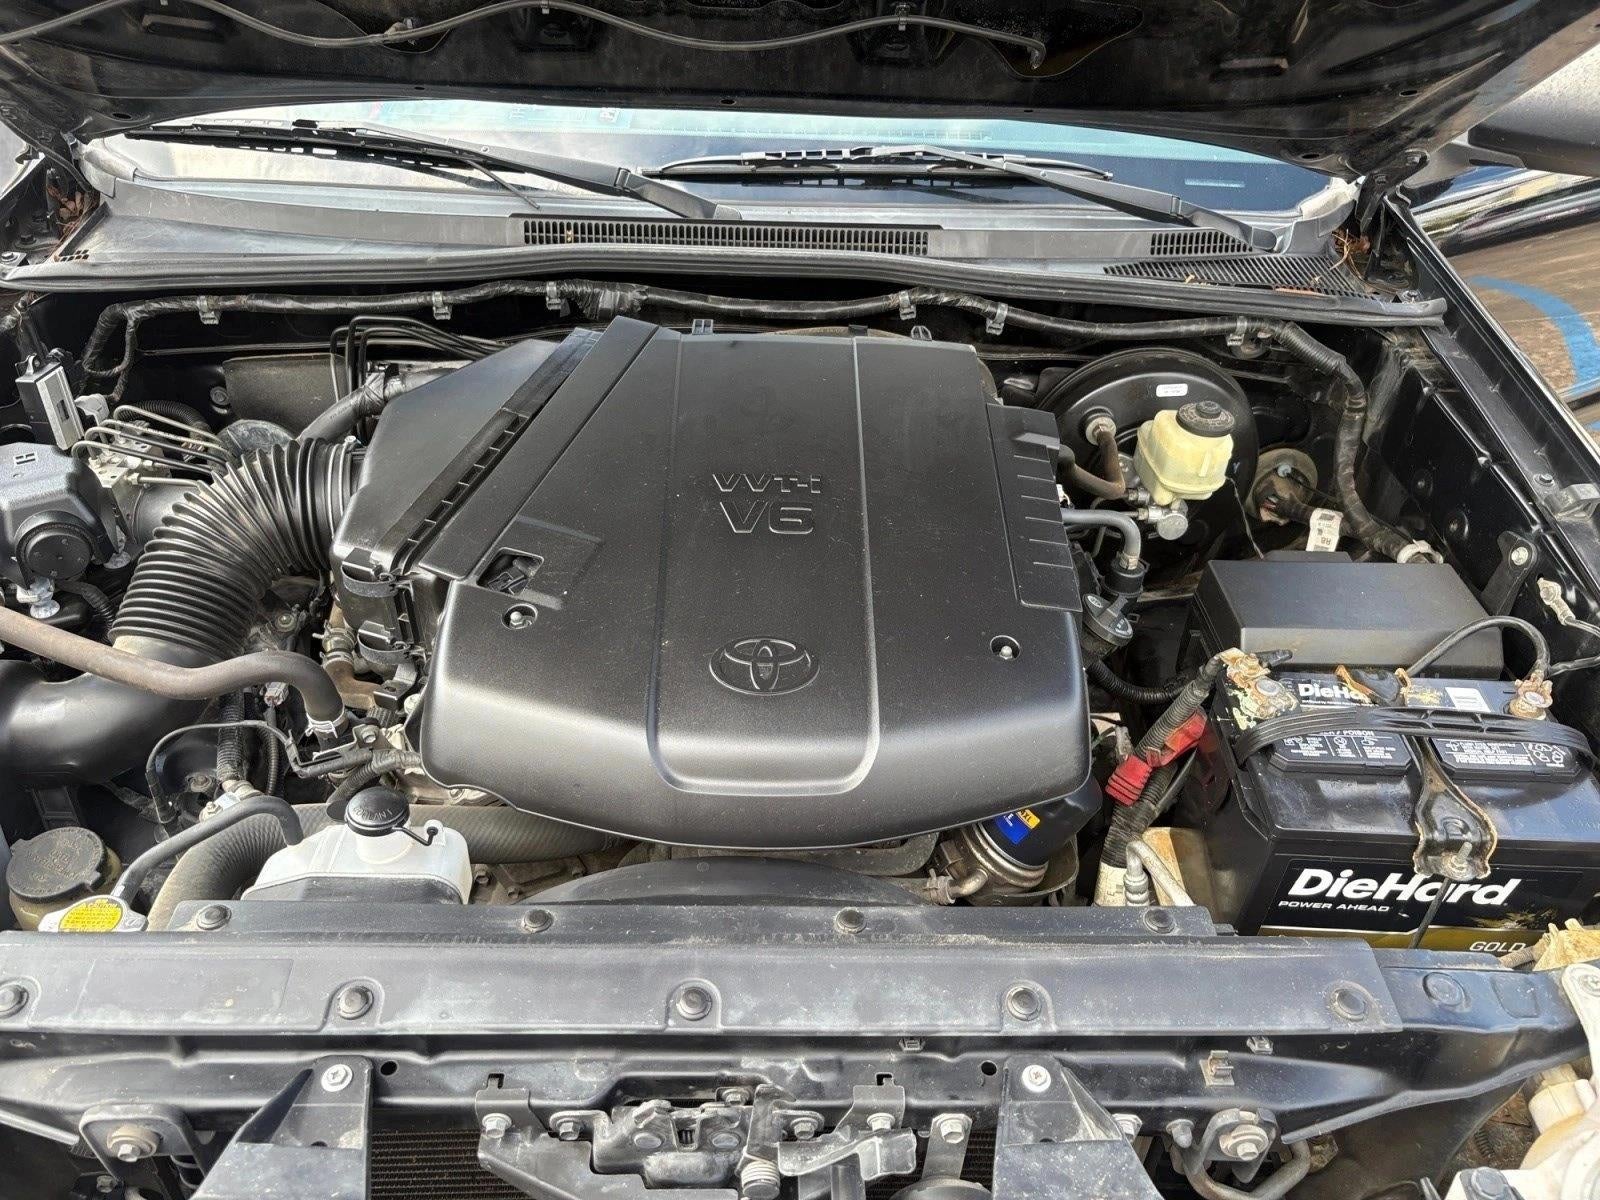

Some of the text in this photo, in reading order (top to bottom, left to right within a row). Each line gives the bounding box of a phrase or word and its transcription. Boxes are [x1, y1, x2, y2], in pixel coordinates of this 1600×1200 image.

[719, 501, 814, 534] V6
[1287, 867, 1523, 906] DieHard
[1278, 900, 1390, 912] POWER AHEAD
[1469, 941, 1527, 953] GOLD
